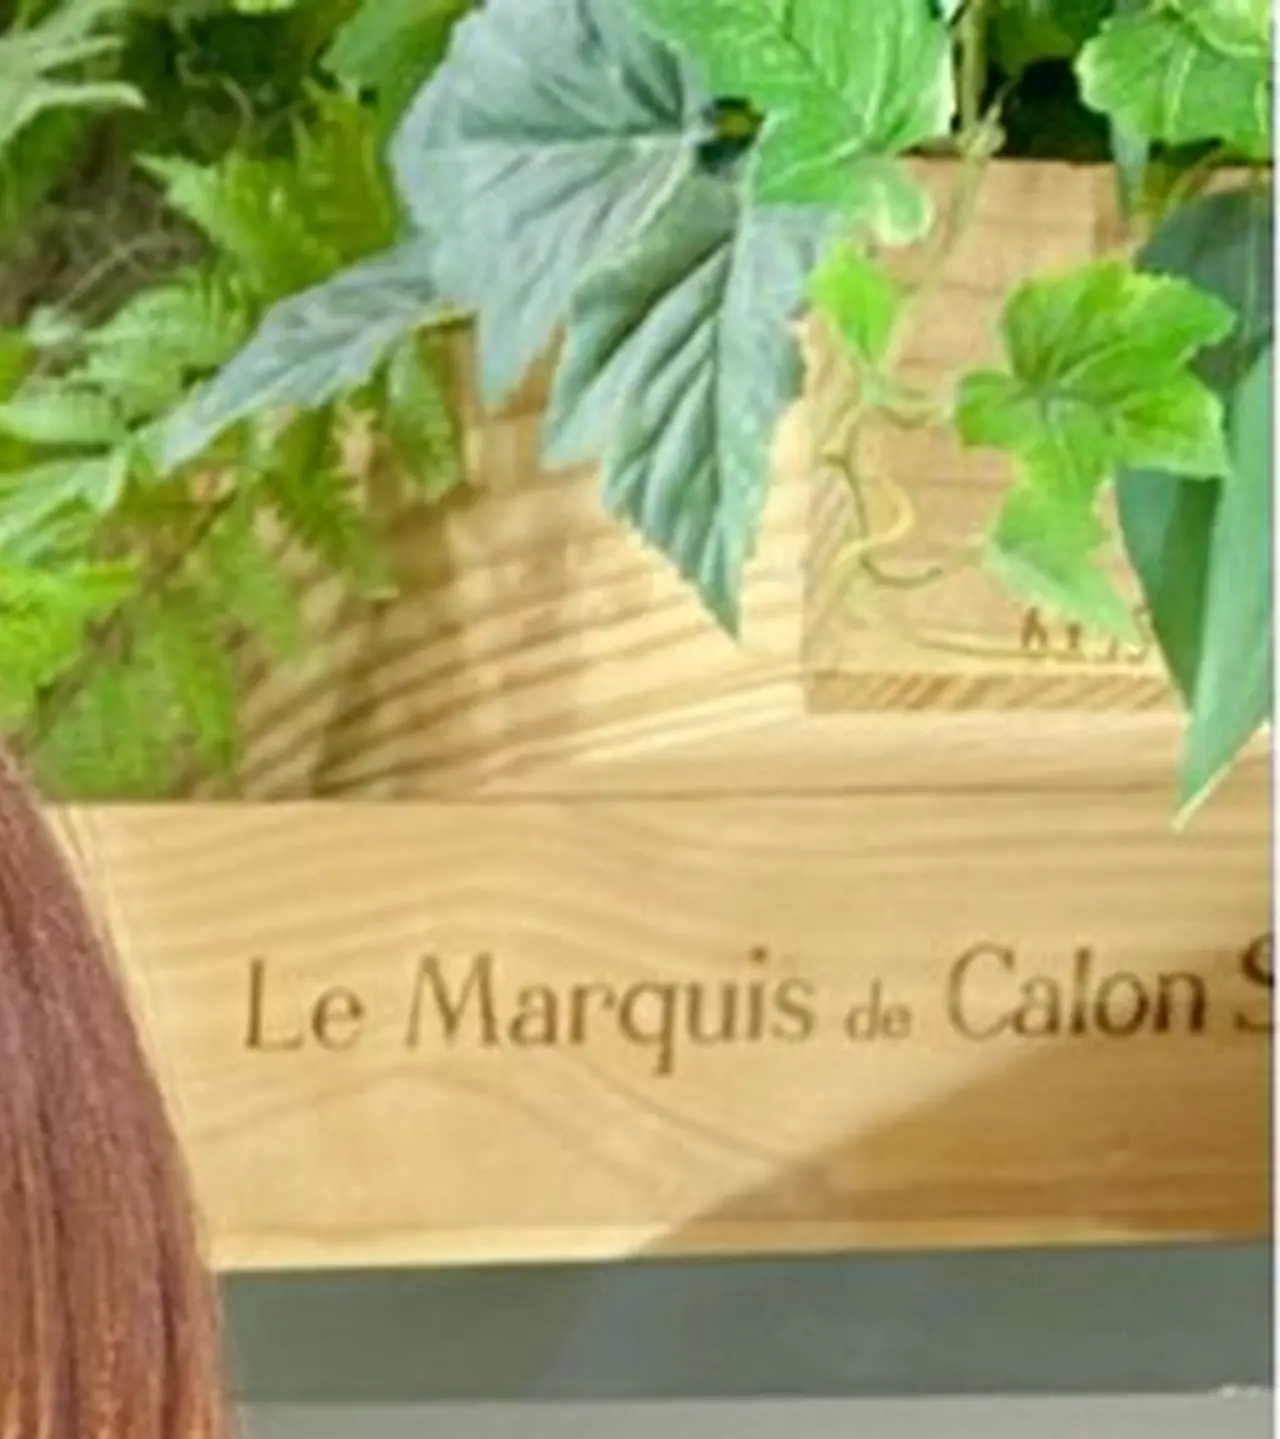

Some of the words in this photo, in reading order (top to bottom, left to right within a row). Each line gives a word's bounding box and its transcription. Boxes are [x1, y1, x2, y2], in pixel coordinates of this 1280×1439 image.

[244, 954, 366, 1053] Le
[404, 943, 818, 1077] Marquis
[842, 976, 915, 1042] de
[945, 940, 1209, 1043] Calon
